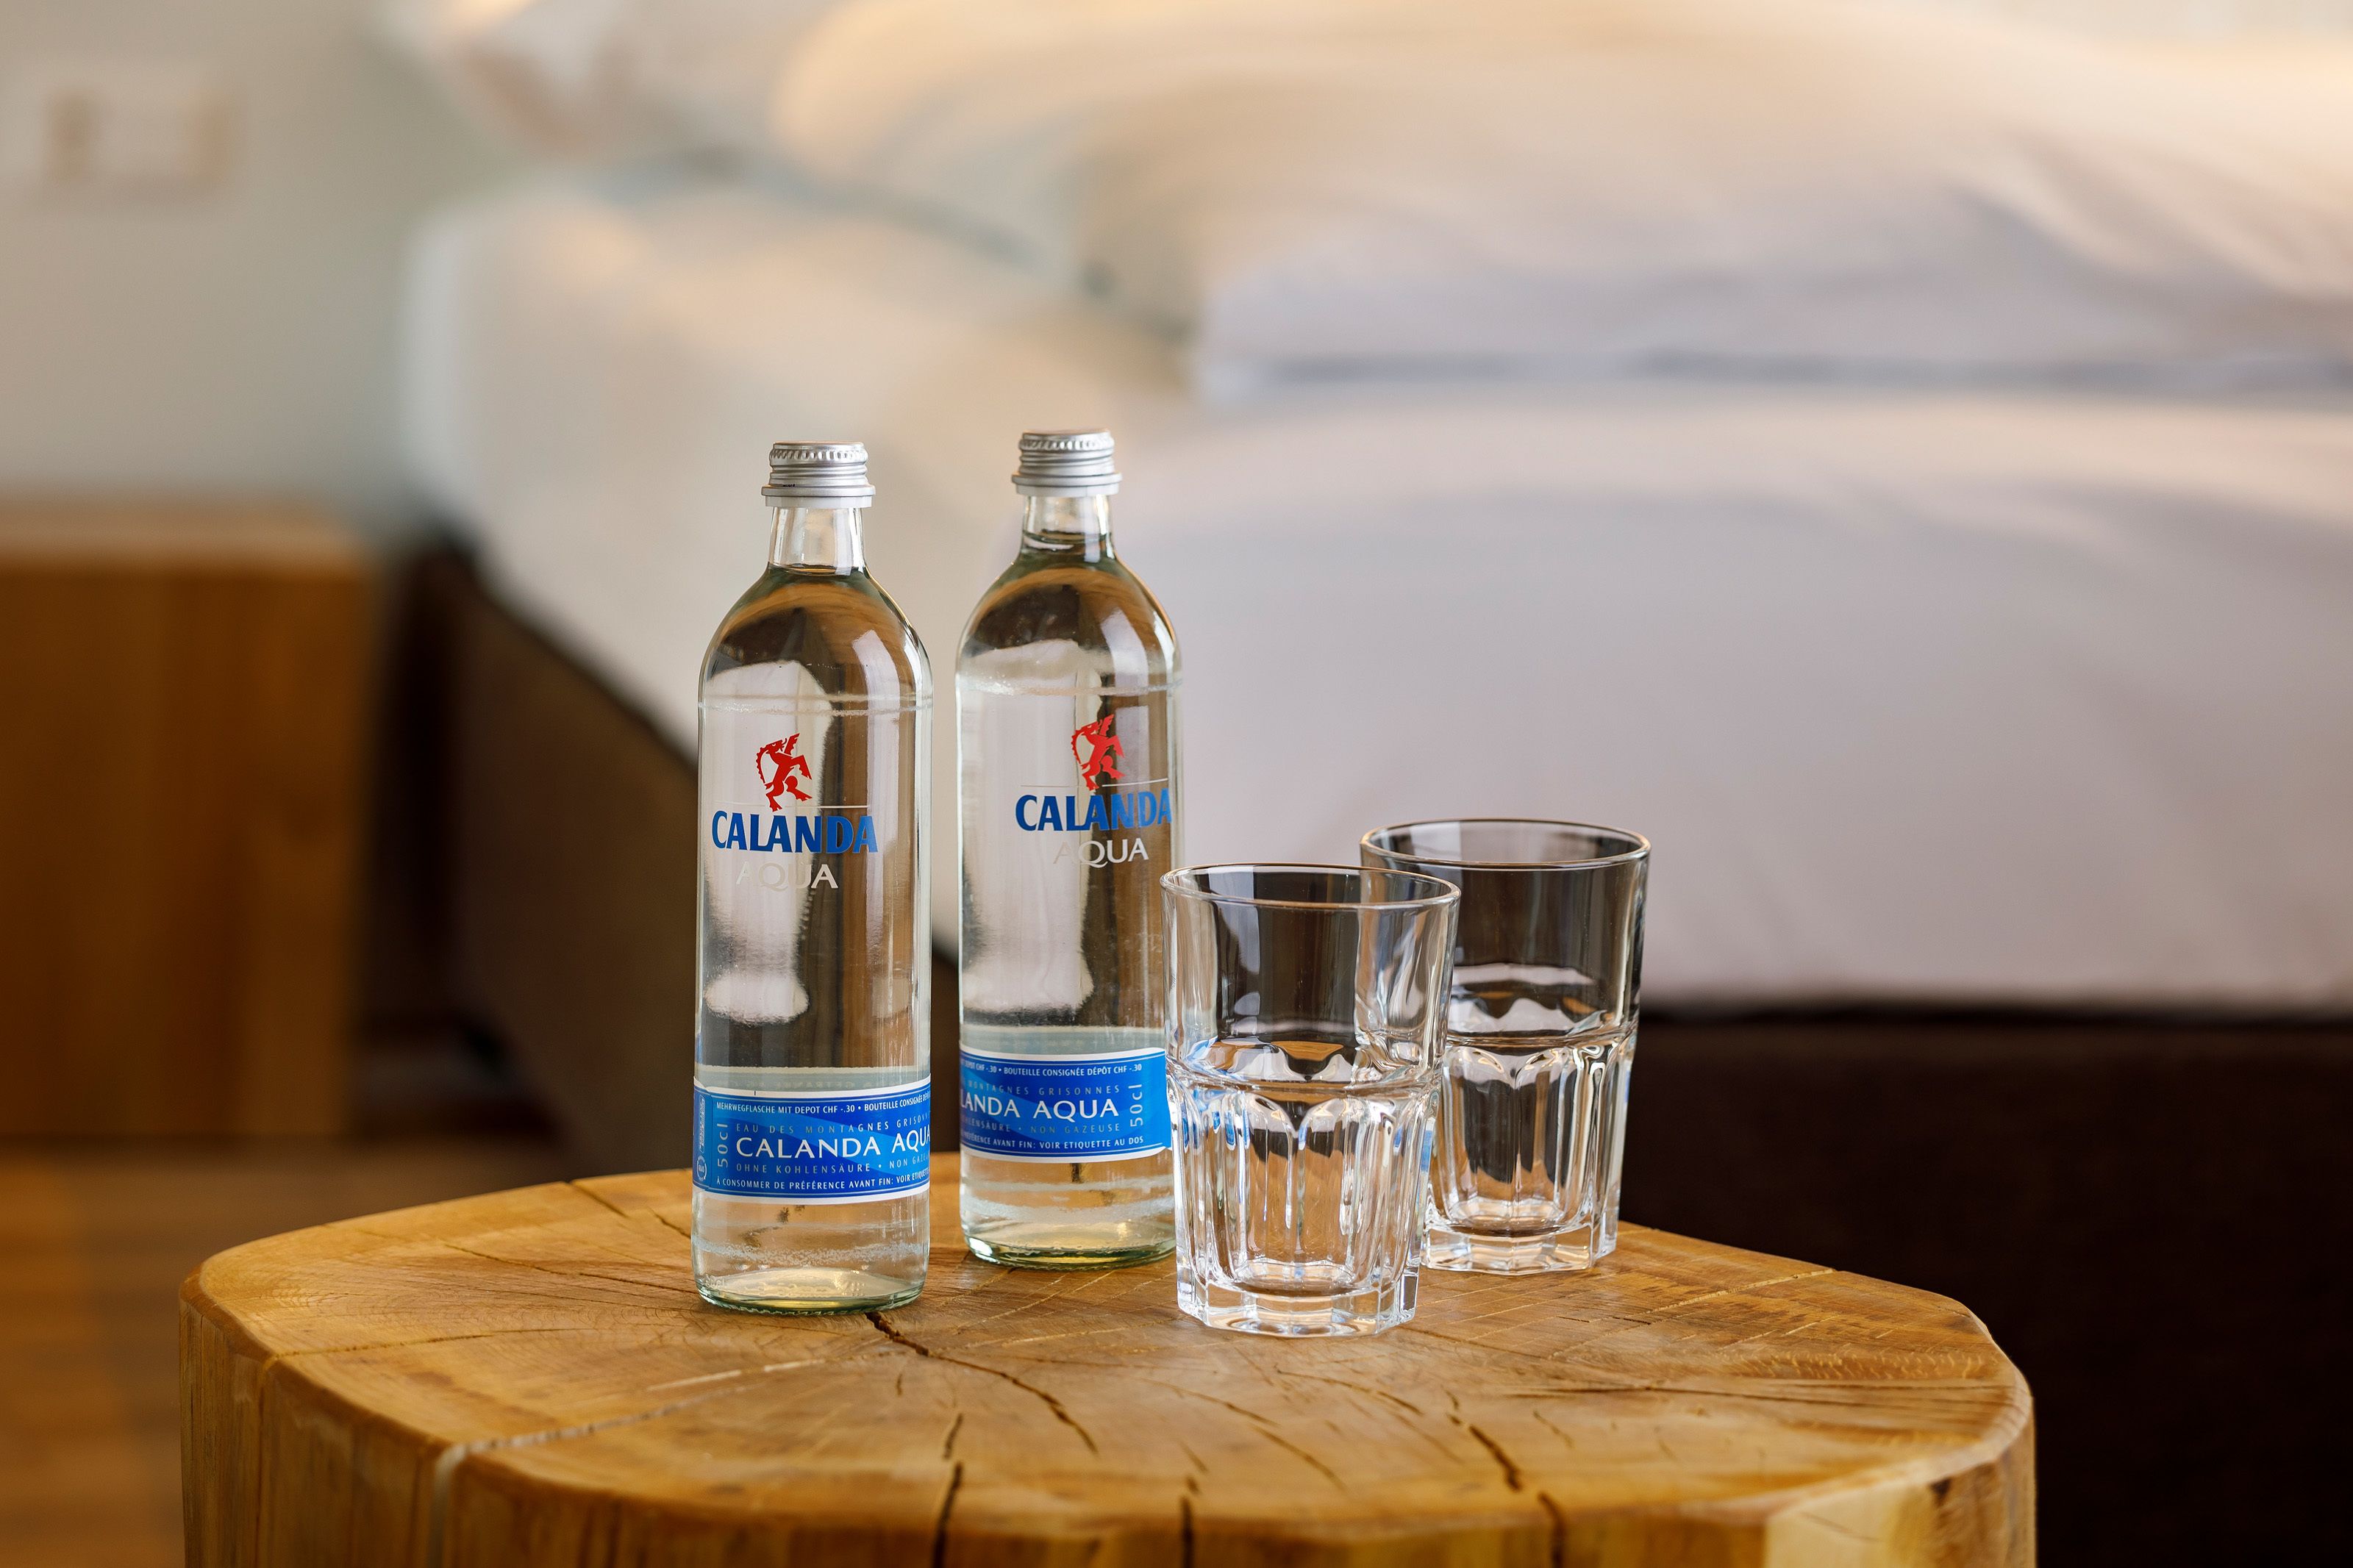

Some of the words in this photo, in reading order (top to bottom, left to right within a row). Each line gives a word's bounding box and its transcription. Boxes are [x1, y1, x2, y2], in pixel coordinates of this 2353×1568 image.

[1015, 787, 1172, 831] CALANDA
[712, 810, 879, 853] CALANDA
[1054, 837, 1149, 868] AQUA
[735, 861, 839, 892] AQUA
[1004, 1067, 1040, 1076] BOUTEILLE
[1043, 1067, 1085, 1076] CONSIGNÉE
[1087, 1066, 1111, 1075] DÉPÔT
[1113, 1065, 1127, 1073] CHF
[968, 1079, 1029, 1095] MONTAGNES
[1038, 1084, 1120, 1095] GRISONNES
[716, 1101, 776, 1114] MEHRWEGFLASCHE
[778, 1106, 792, 1114] MIT
[795, 1106, 820, 1114] DEPOT
[823, 1105, 838, 1113] CHF
[864, 1100, 899, 1111] BOUTEILLE
[899, 1095, 923, 1107] CONSIGNÉE
[1032, 1098, 1119, 1123] AQUA
[1128, 1084, 1143, 1128] 50cl
[736, 1123, 759, 1133] EAU
[769, 1125, 794, 1134] DES
[805, 1120, 890, 1134] MONTAGNES
[1031, 1126, 1056, 1134] NON
[1064, 1123, 1120, 1134] GAZEUSE
[717, 1122, 729, 1168] 50cl
[736, 1136, 881, 1159] CALANDA
[891, 1124, 930, 1153] AQUA
[993, 1139, 1015, 1148] AVANT
[1064, 1139, 1111, 1150] ETIQUETTE
[1114, 1138, 1125, 1146] AU
[1129, 1136, 1144, 1145] DOS
[736, 1163, 768, 1173] OHNE
[776, 1162, 871, 1174] KOHLENSÄURE
[889, 1158, 908, 1169] NON
[723, 1178, 771, 1189] CONSOMMER
[774, 1181, 785, 1189] DE
[849, 1178, 876, 1189] AVANT
[896, 1175, 911, 1184] VOIR
